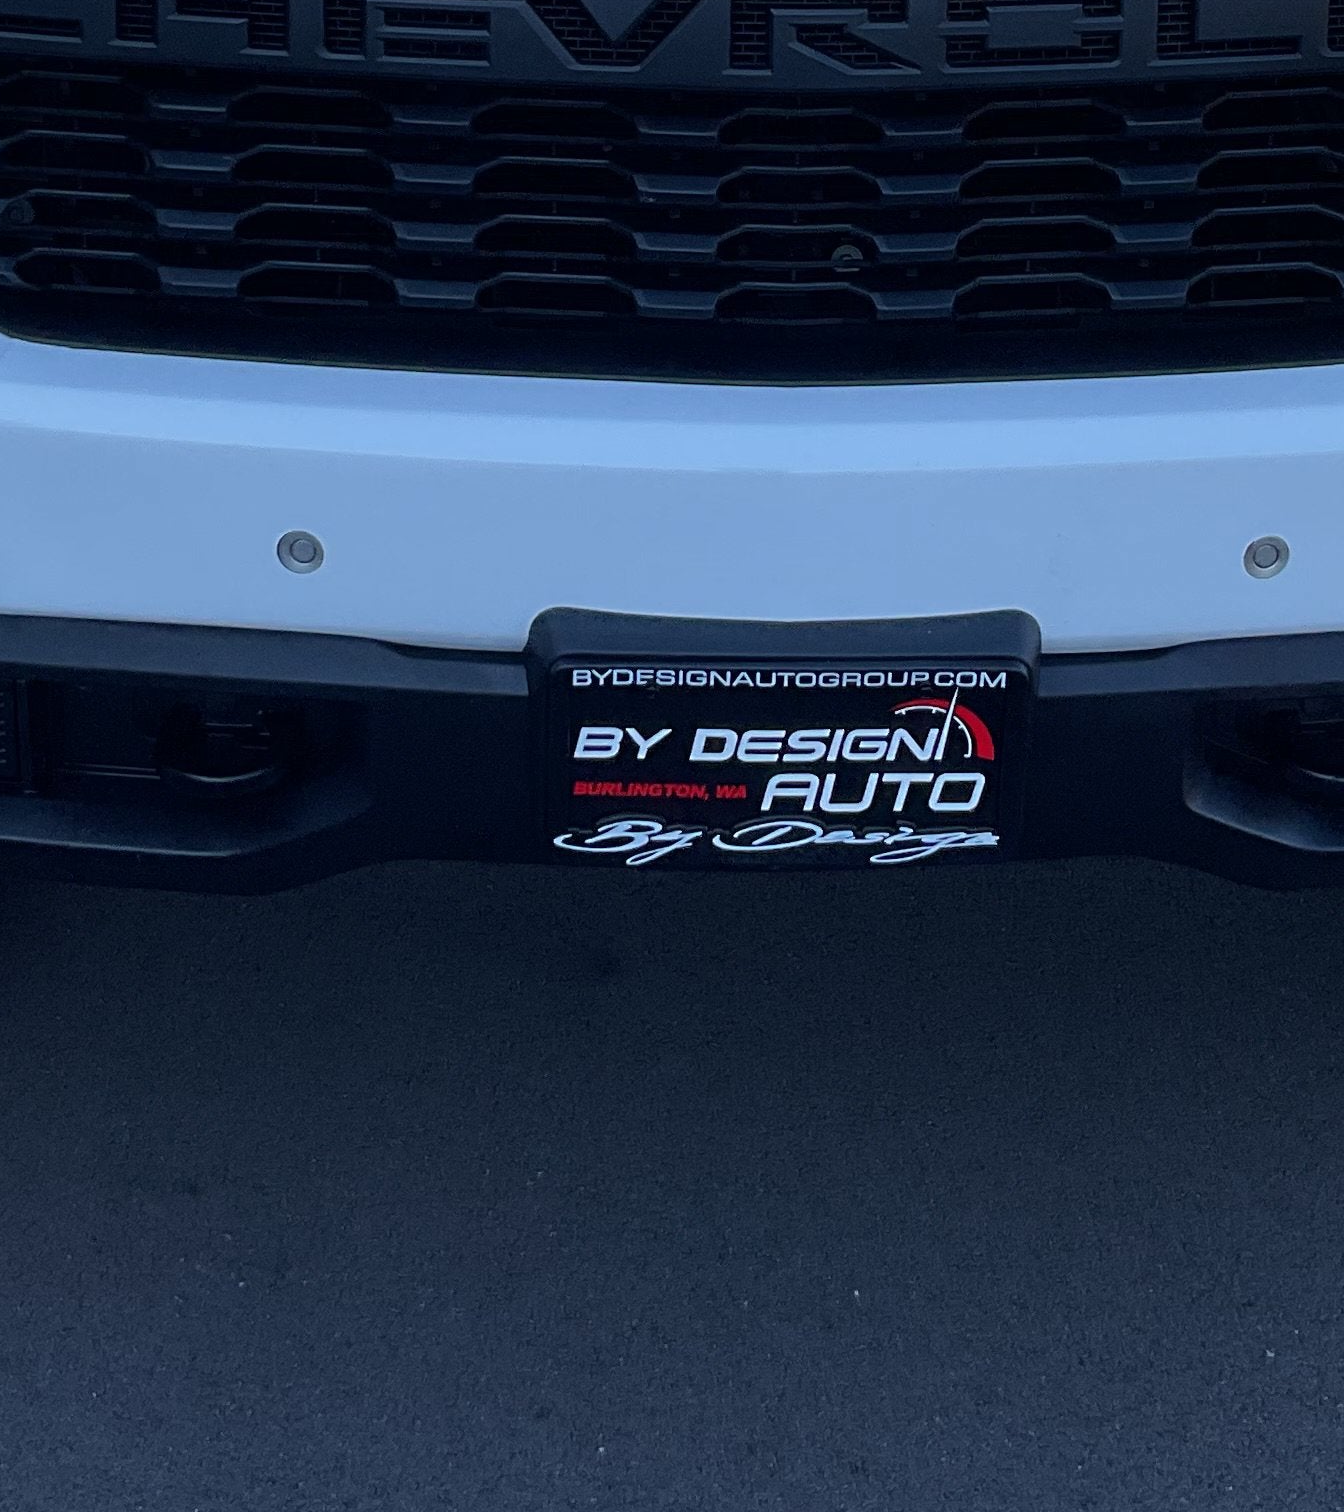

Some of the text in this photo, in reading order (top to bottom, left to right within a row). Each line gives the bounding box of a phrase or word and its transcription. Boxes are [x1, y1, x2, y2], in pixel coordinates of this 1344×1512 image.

[572, 668, 1007, 689] BYDESIGNAUTOGROUP.COM
[573, 726, 953, 763] BY DESIGN
[573, 781, 747, 800] BURLINGTON, WA
[760, 772, 986, 813] AUTO
[553, 820, 703, 866] By
